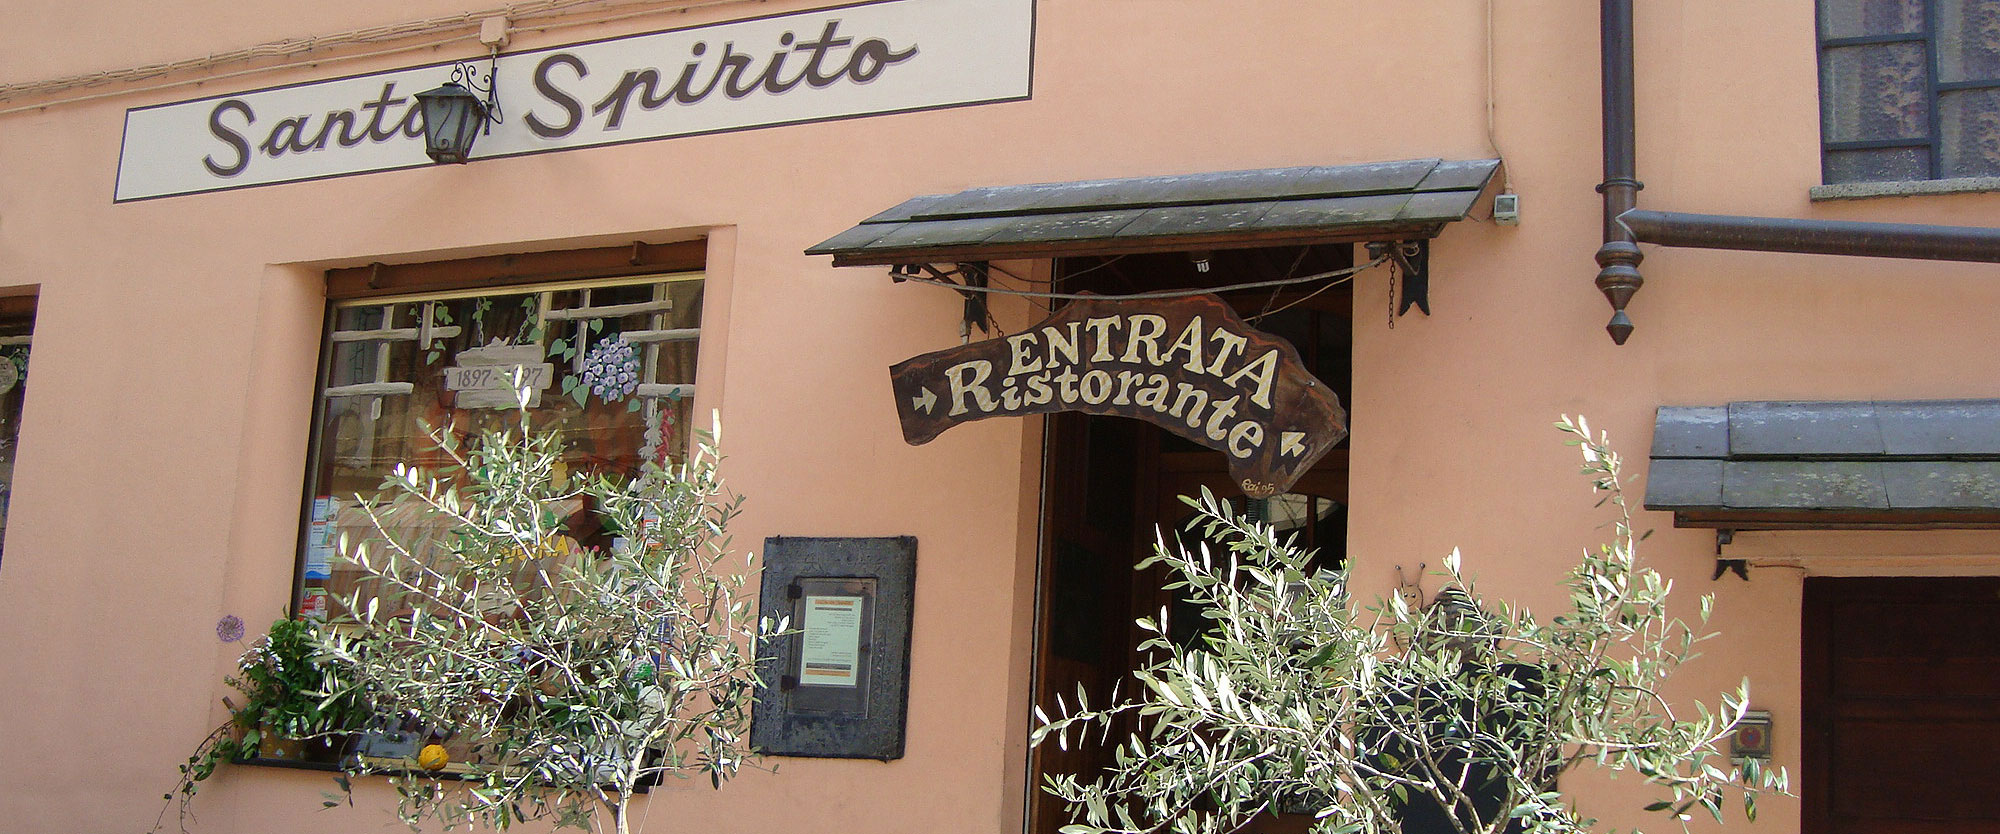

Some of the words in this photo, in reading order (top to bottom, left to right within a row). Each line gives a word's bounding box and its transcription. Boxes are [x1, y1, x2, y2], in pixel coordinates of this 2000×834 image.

[522, 19, 921, 140] Spirito
[457, 368, 491, 388] 1897
[945, 358, 1265, 459] Ristorante
[1007, 314, 1279, 410] ENTRATA
